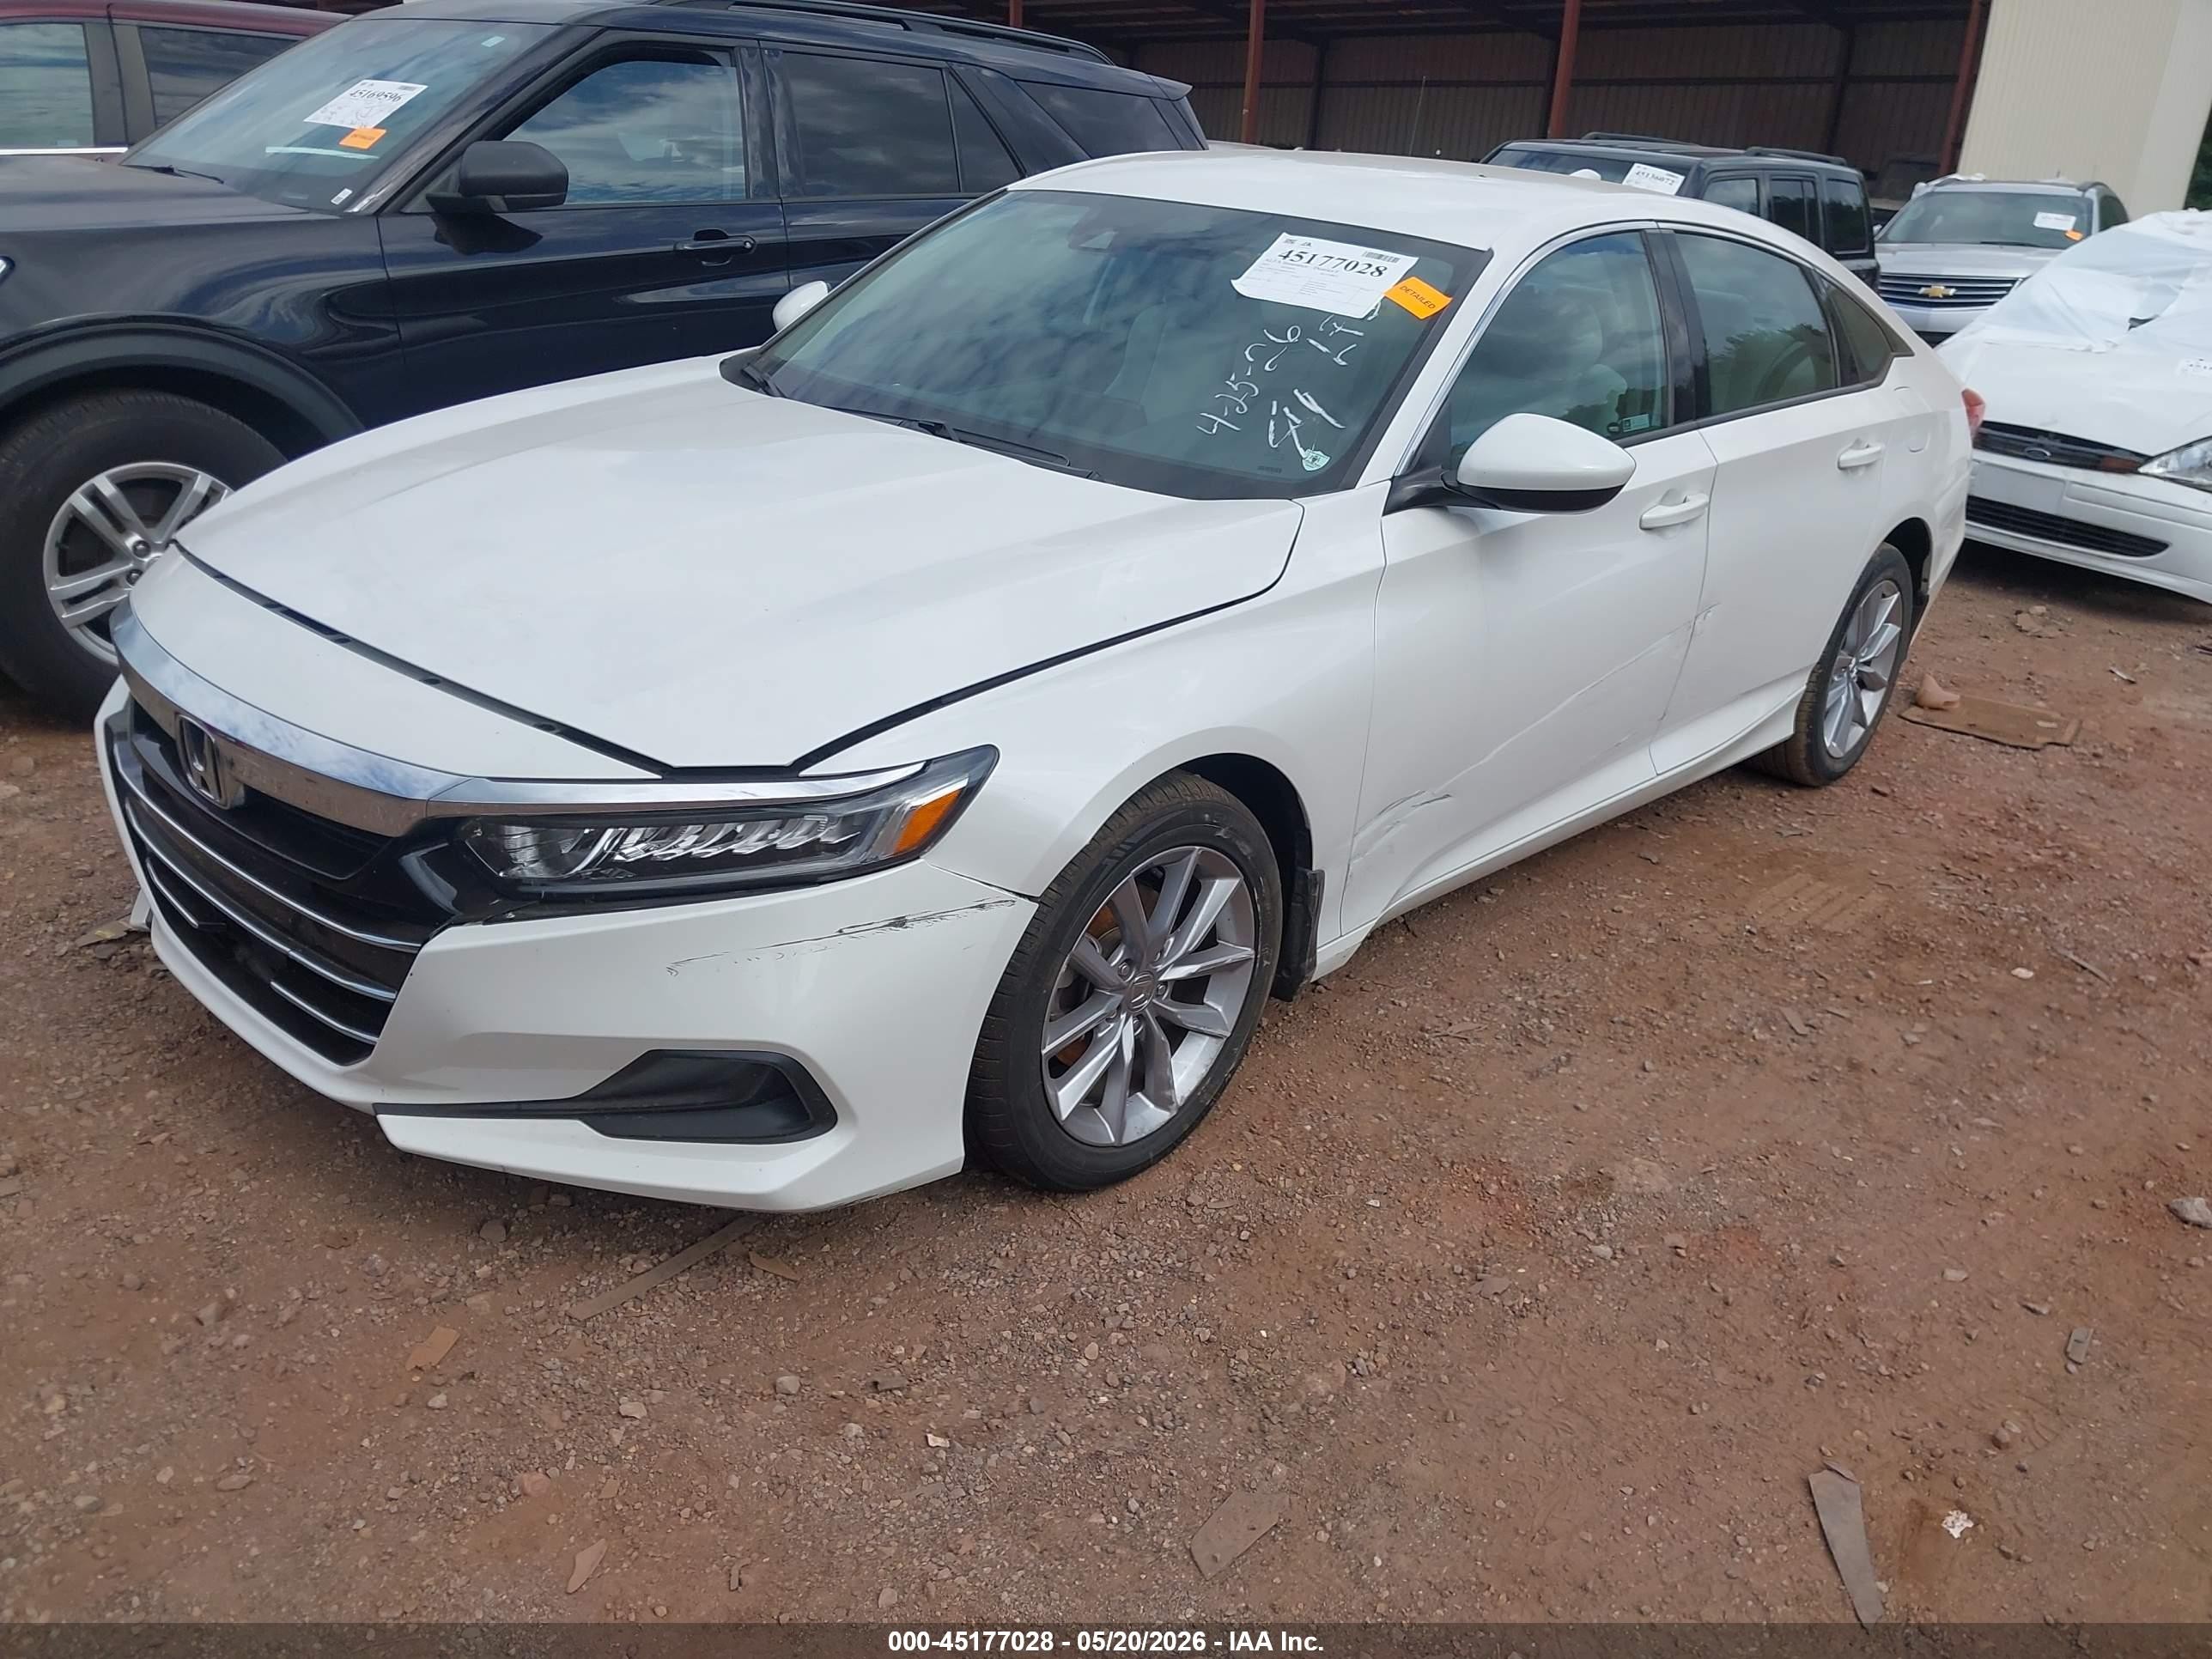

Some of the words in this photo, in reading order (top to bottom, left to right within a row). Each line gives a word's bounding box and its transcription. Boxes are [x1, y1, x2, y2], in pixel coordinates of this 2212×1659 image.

[349, 88, 403, 102] 45169596
[1278, 249, 1389, 278] 45177028
[1398, 285, 1437, 310] DETAILED
